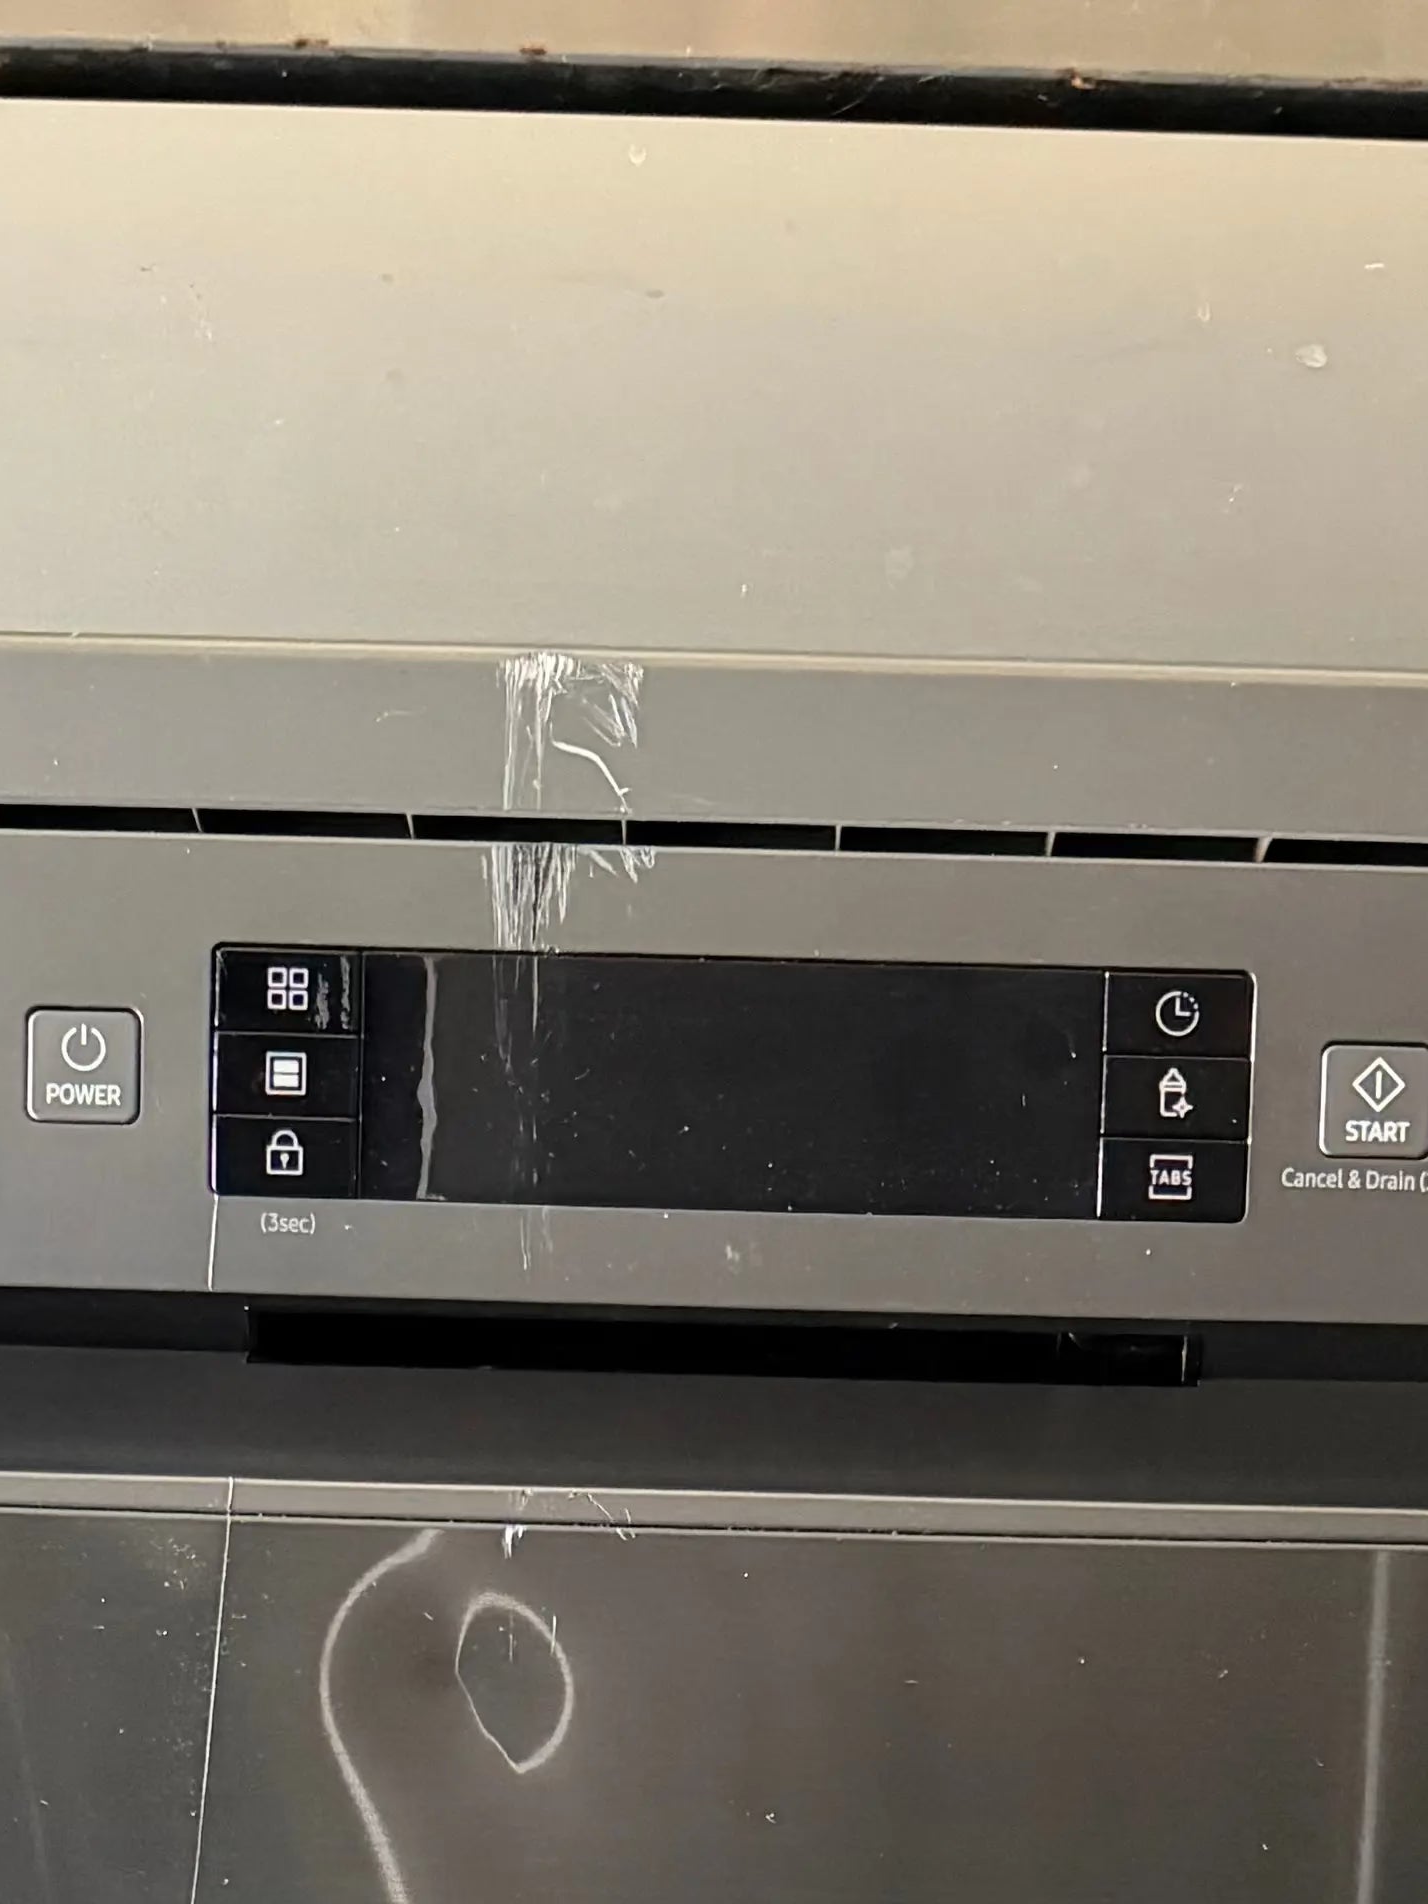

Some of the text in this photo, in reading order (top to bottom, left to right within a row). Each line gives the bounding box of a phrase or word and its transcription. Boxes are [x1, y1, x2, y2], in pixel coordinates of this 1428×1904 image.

[45, 1082, 122, 1107] POWER
[1345, 1119, 1411, 1143] START
[1149, 1169, 1193, 1186] TABS
[1281, 1167, 1344, 1189] Cancel
[1347, 1169, 1361, 1190] &
[1366, 1169, 1416, 1192] Drain
[259, 1211, 316, 1235] (3sec)
